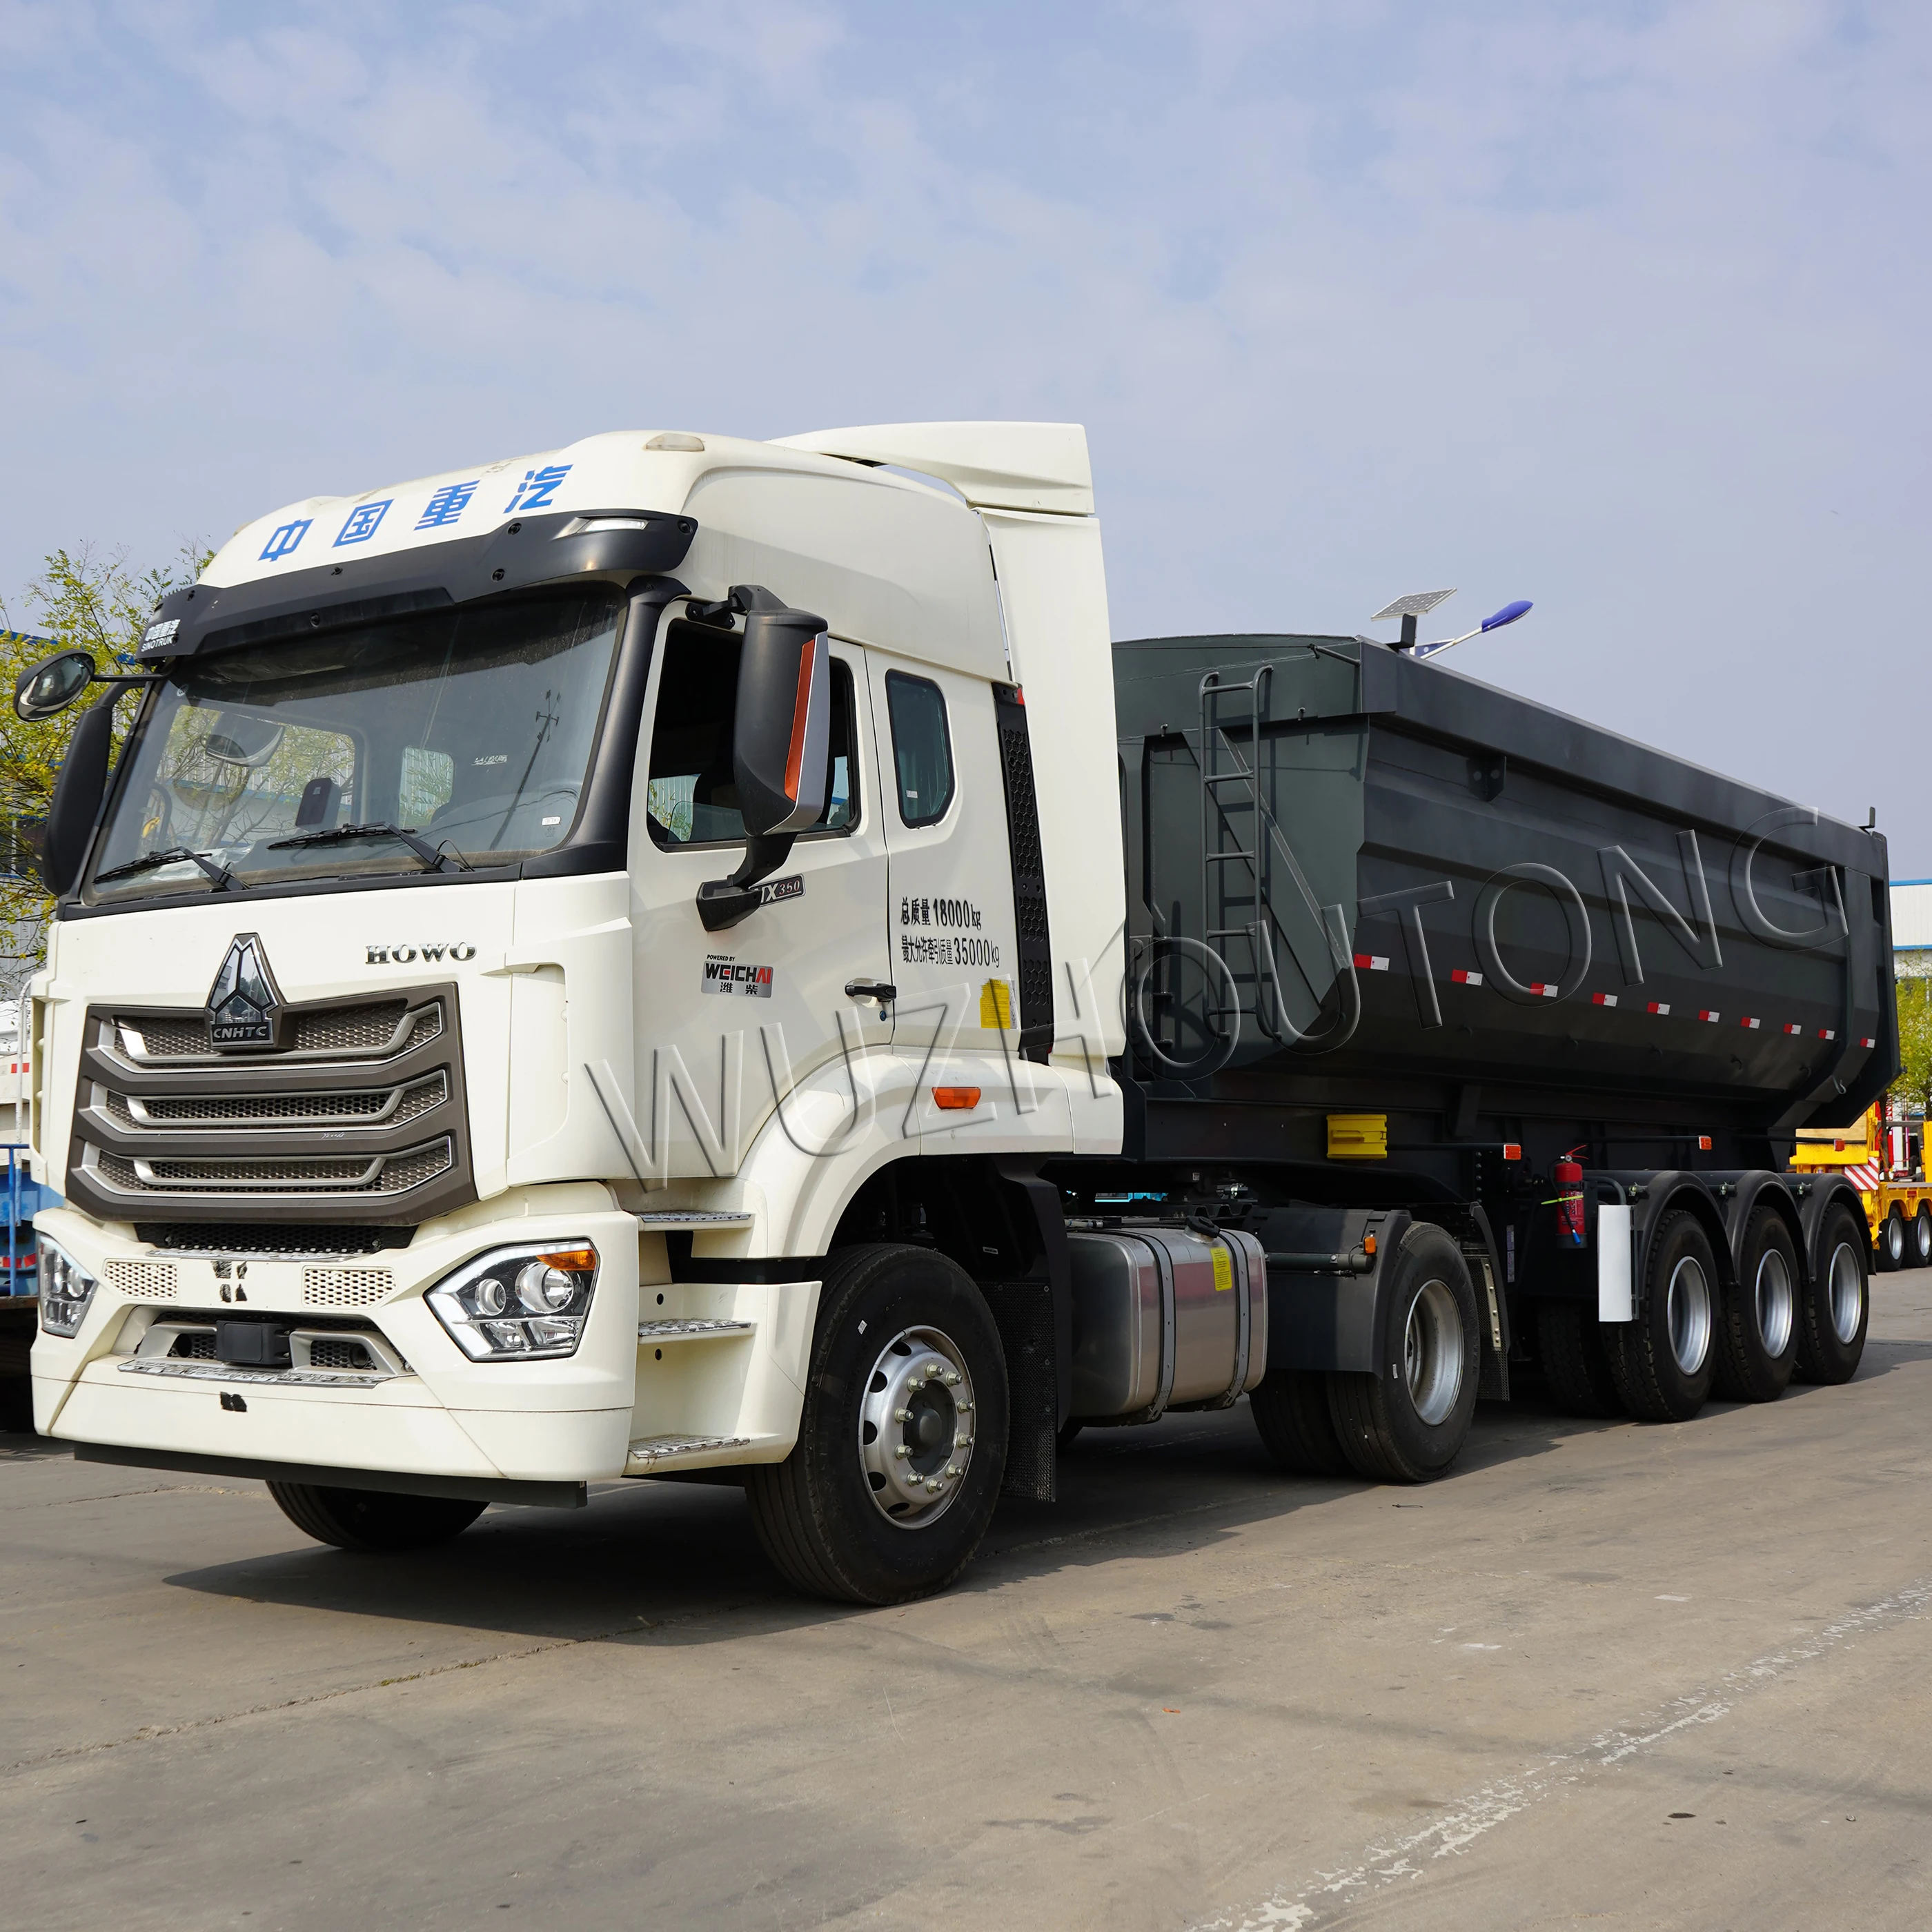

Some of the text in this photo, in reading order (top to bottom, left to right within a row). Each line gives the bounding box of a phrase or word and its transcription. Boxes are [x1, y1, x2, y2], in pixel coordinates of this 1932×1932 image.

[257, 464, 573, 562] 中国重汽
[141, 635, 175, 652] SINOTRUK
[900, 896, 981, 931] 总质量 18000kg
[365, 941, 477, 965] HOWO
[901, 934, 1000, 968] 最大允许牵引质量 35000kg
[705, 963, 772, 984] WEICHAI
[720, 982, 758, 995] 潍柴
[213, 1026, 267, 1038] CNHTC
